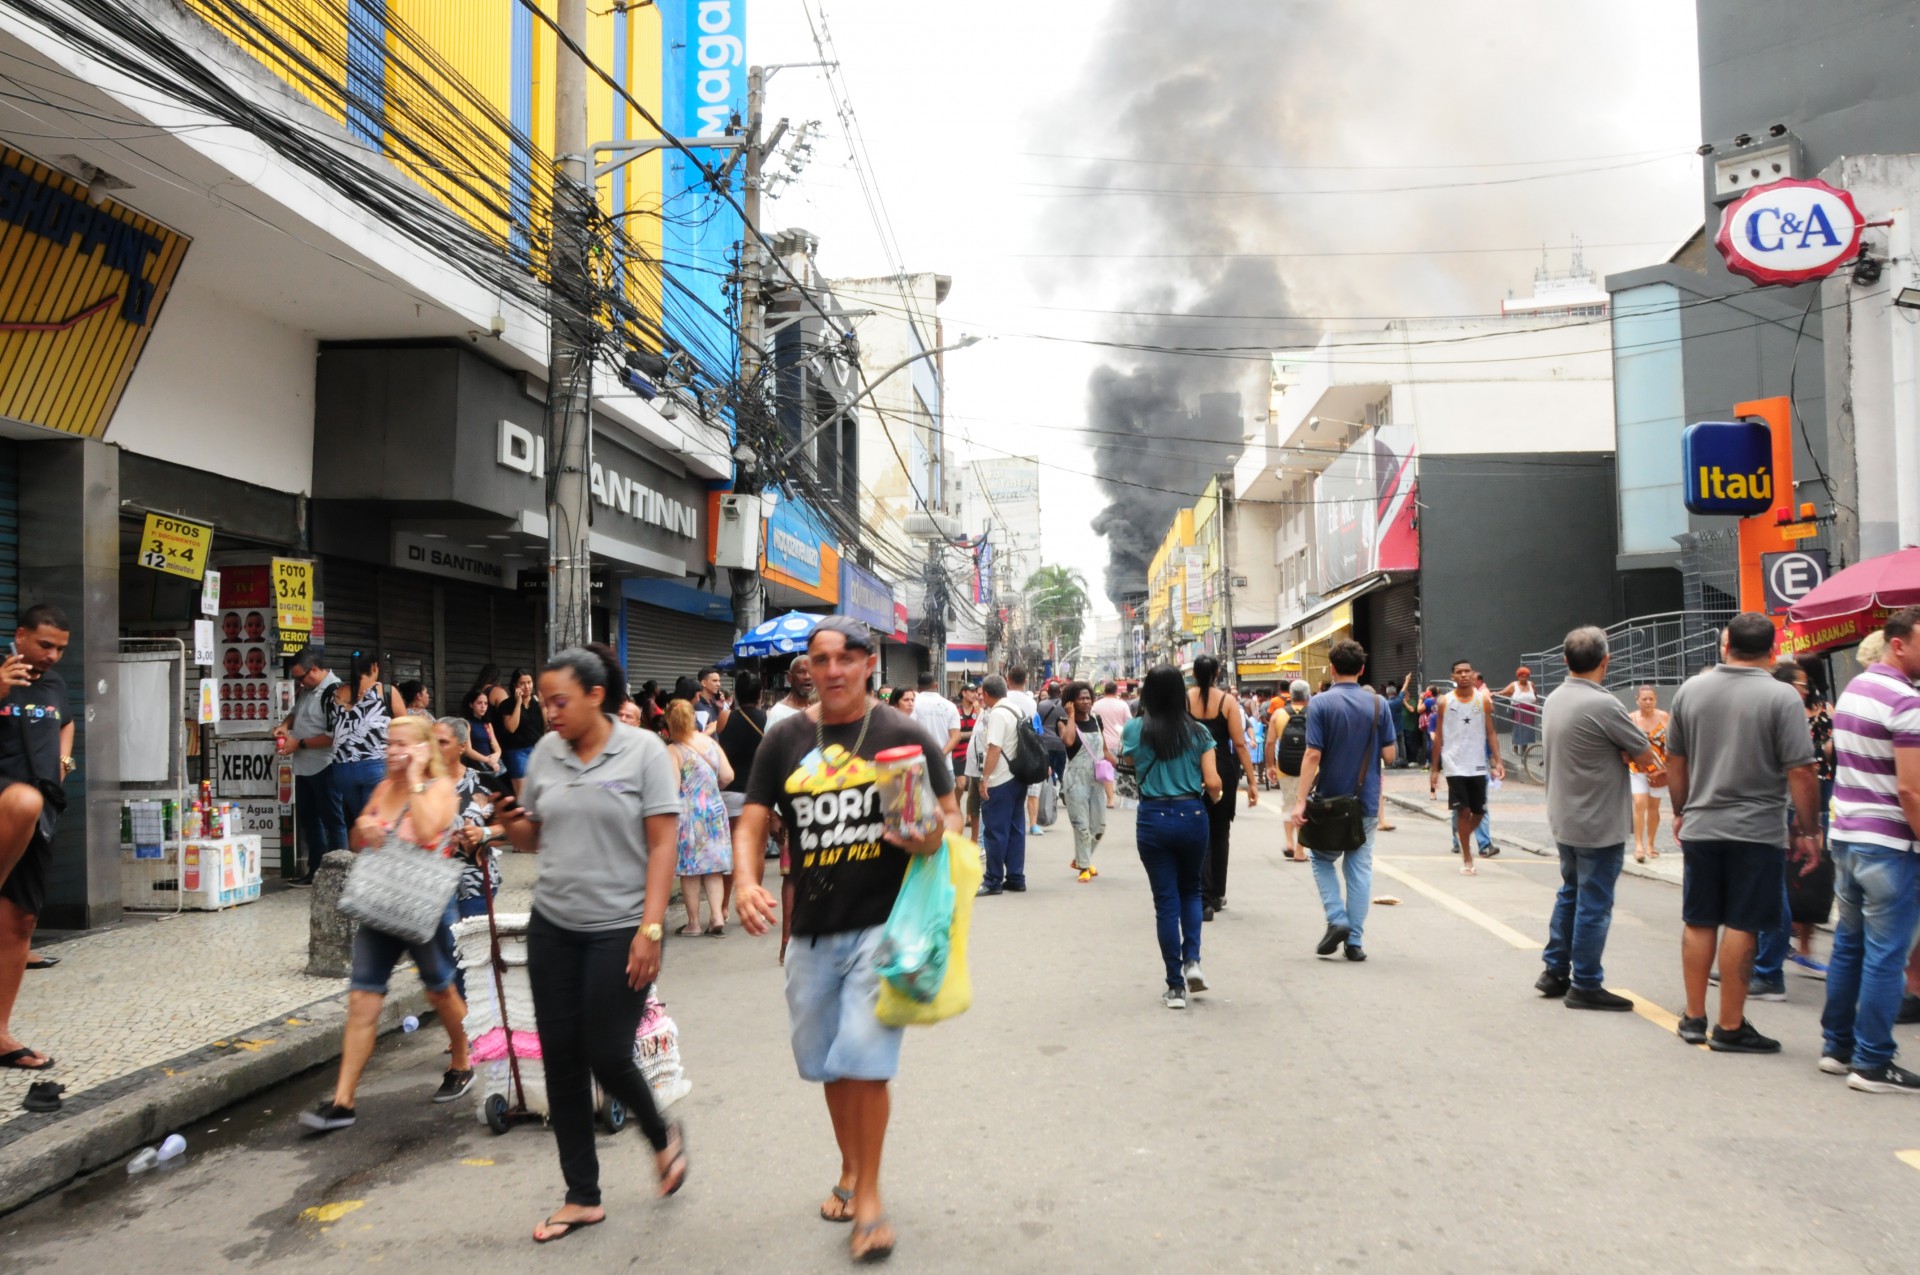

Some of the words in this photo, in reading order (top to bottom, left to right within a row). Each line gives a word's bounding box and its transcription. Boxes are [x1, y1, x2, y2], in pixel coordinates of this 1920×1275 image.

[1745, 203, 1842, 253] C&A
[497, 419, 545, 479] DI
[590, 452, 697, 540] ANTINNI
[1700, 466, 1772, 499] Itaú
[155, 519, 200, 538] FOTOS
[145, 552, 166, 568] 12
[166, 561, 195, 575] minutos
[408, 545, 425, 562] DI
[431, 550, 503, 578] SANTINNI
[280, 565, 306, 577] FOTO
[1782, 561, 1811, 596] E
[280, 603, 306, 612] DIGITAL
[280, 631, 308, 642] XEROX
[1779, 639, 1793, 655] REI
[1794, 636, 1811, 651] DAS
[1811, 620, 1856, 647] LARANJAS
[222, 755, 274, 780] XEROX
[247, 804, 274, 816] Agua
[249, 819, 273, 830] 2,00
[819, 847, 844, 866] EAT
[847, 842, 881, 862] PIZZA
